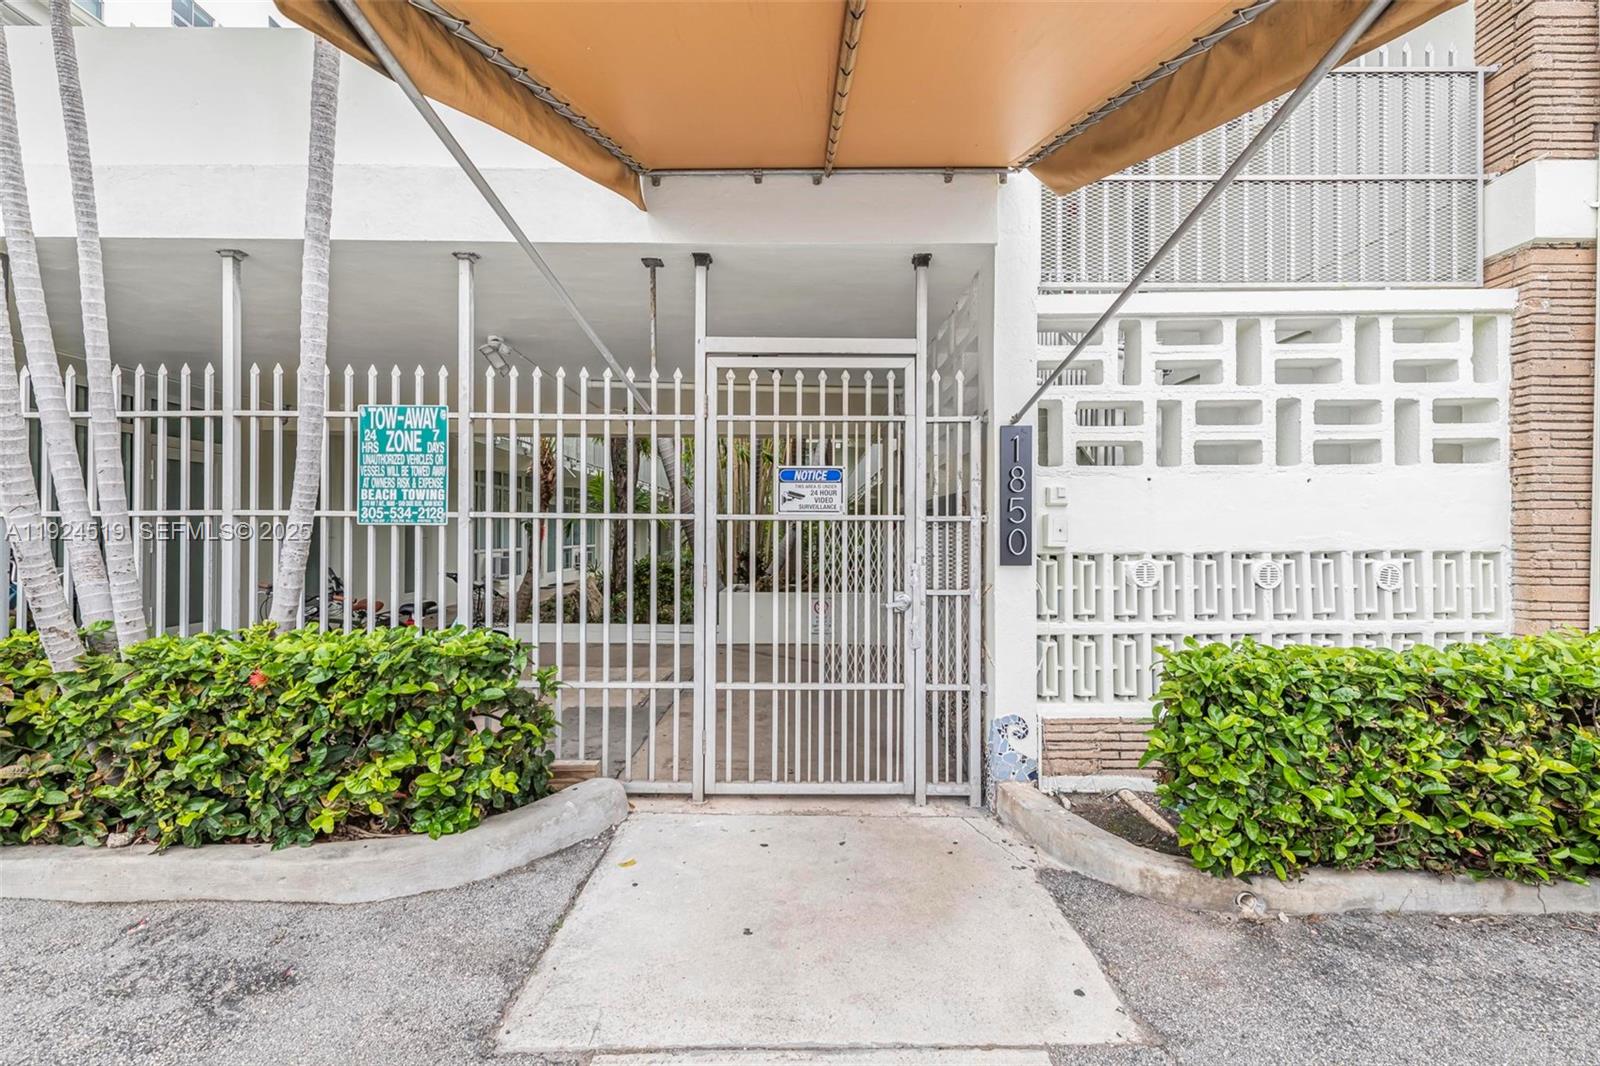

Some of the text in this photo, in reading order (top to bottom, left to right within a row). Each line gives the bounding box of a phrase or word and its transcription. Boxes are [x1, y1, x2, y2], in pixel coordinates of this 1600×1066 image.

[368, 407, 439, 429] TOW-AWAY
[364, 429, 377, 441] 24
[432, 430, 440, 440] 7
[385, 430, 423, 452] ZONE
[361, 442, 380, 453] HRS
[427, 442, 445, 453] DAYS
[362, 454, 444, 465] UNAUTHORIZED VEHICLES OR
[361, 465, 447, 476] VESSELS WILL BE TOWED AWAY
[794, 470, 828, 480] NOTICE
[362, 477, 444, 488] AT OWNERS RISK & EXPENSE
[361, 489, 445, 500] BEACH TOWING
[1007, 435, 1027, 556] 1850
[361, 507, 445, 519] 305-534-2128
